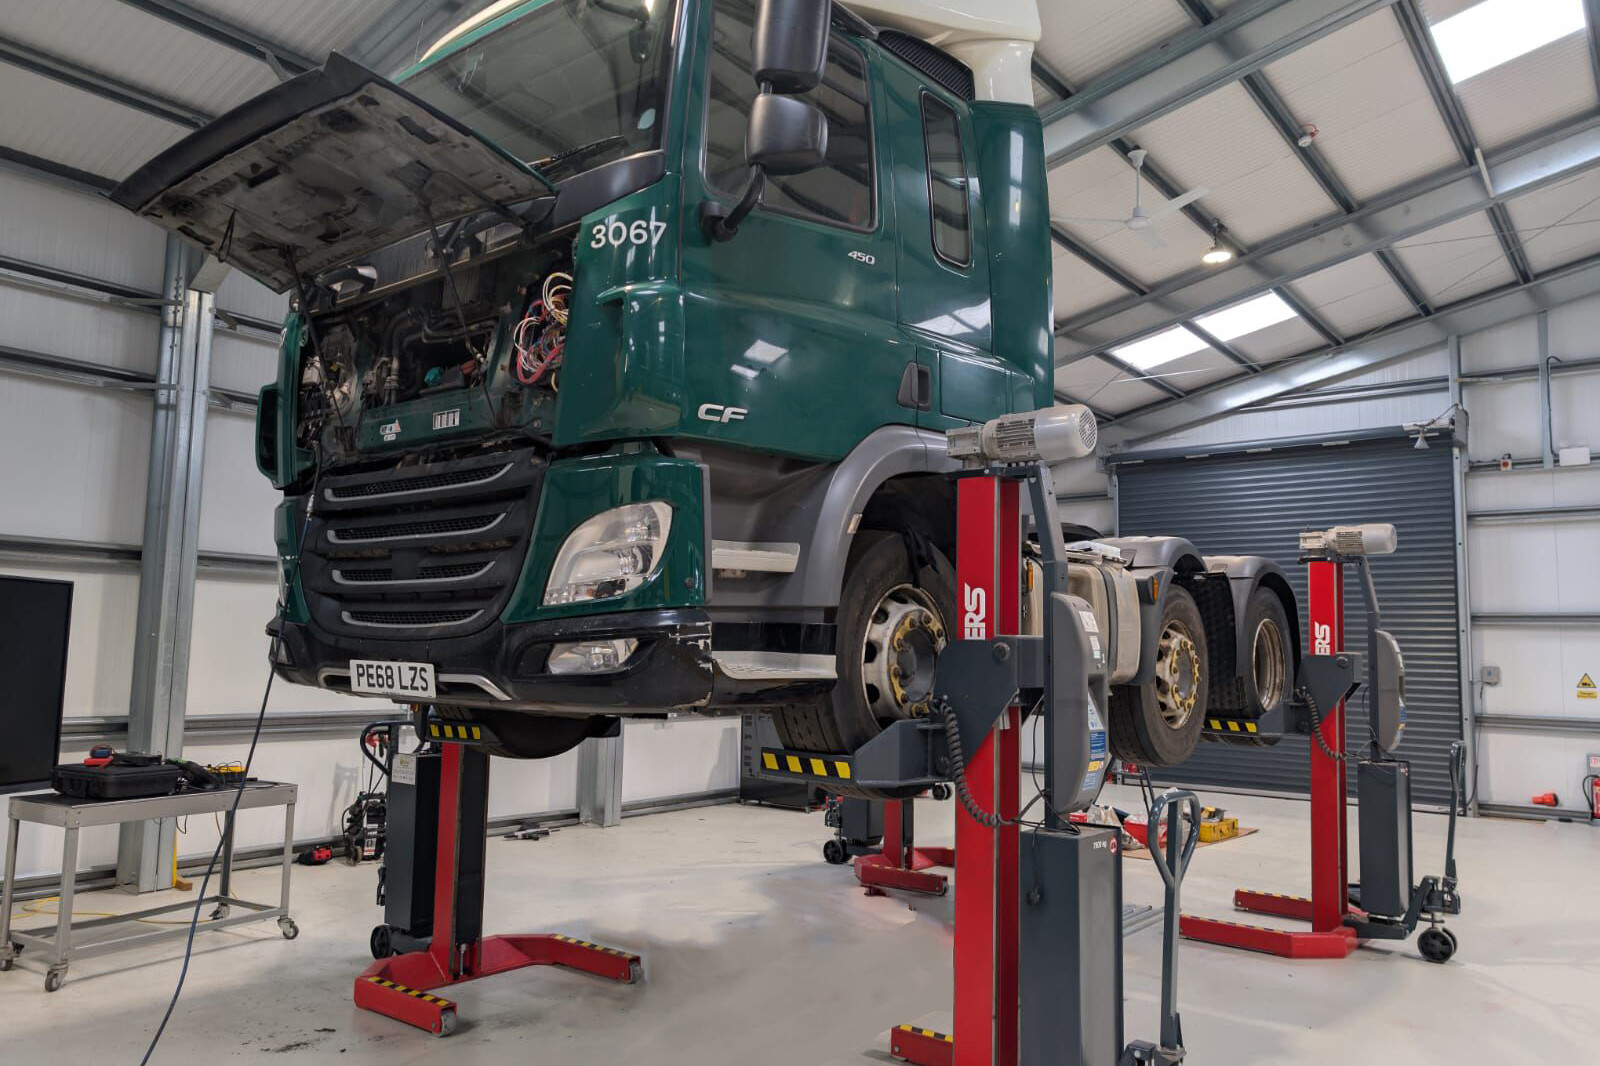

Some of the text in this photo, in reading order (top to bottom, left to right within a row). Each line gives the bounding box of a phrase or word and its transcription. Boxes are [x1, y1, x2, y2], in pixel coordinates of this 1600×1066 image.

[590, 219, 667, 249] 3067
[848, 250, 876, 265] 450
[697, 403, 748, 423] CF
[356, 663, 429, 692] PE68 LZS
